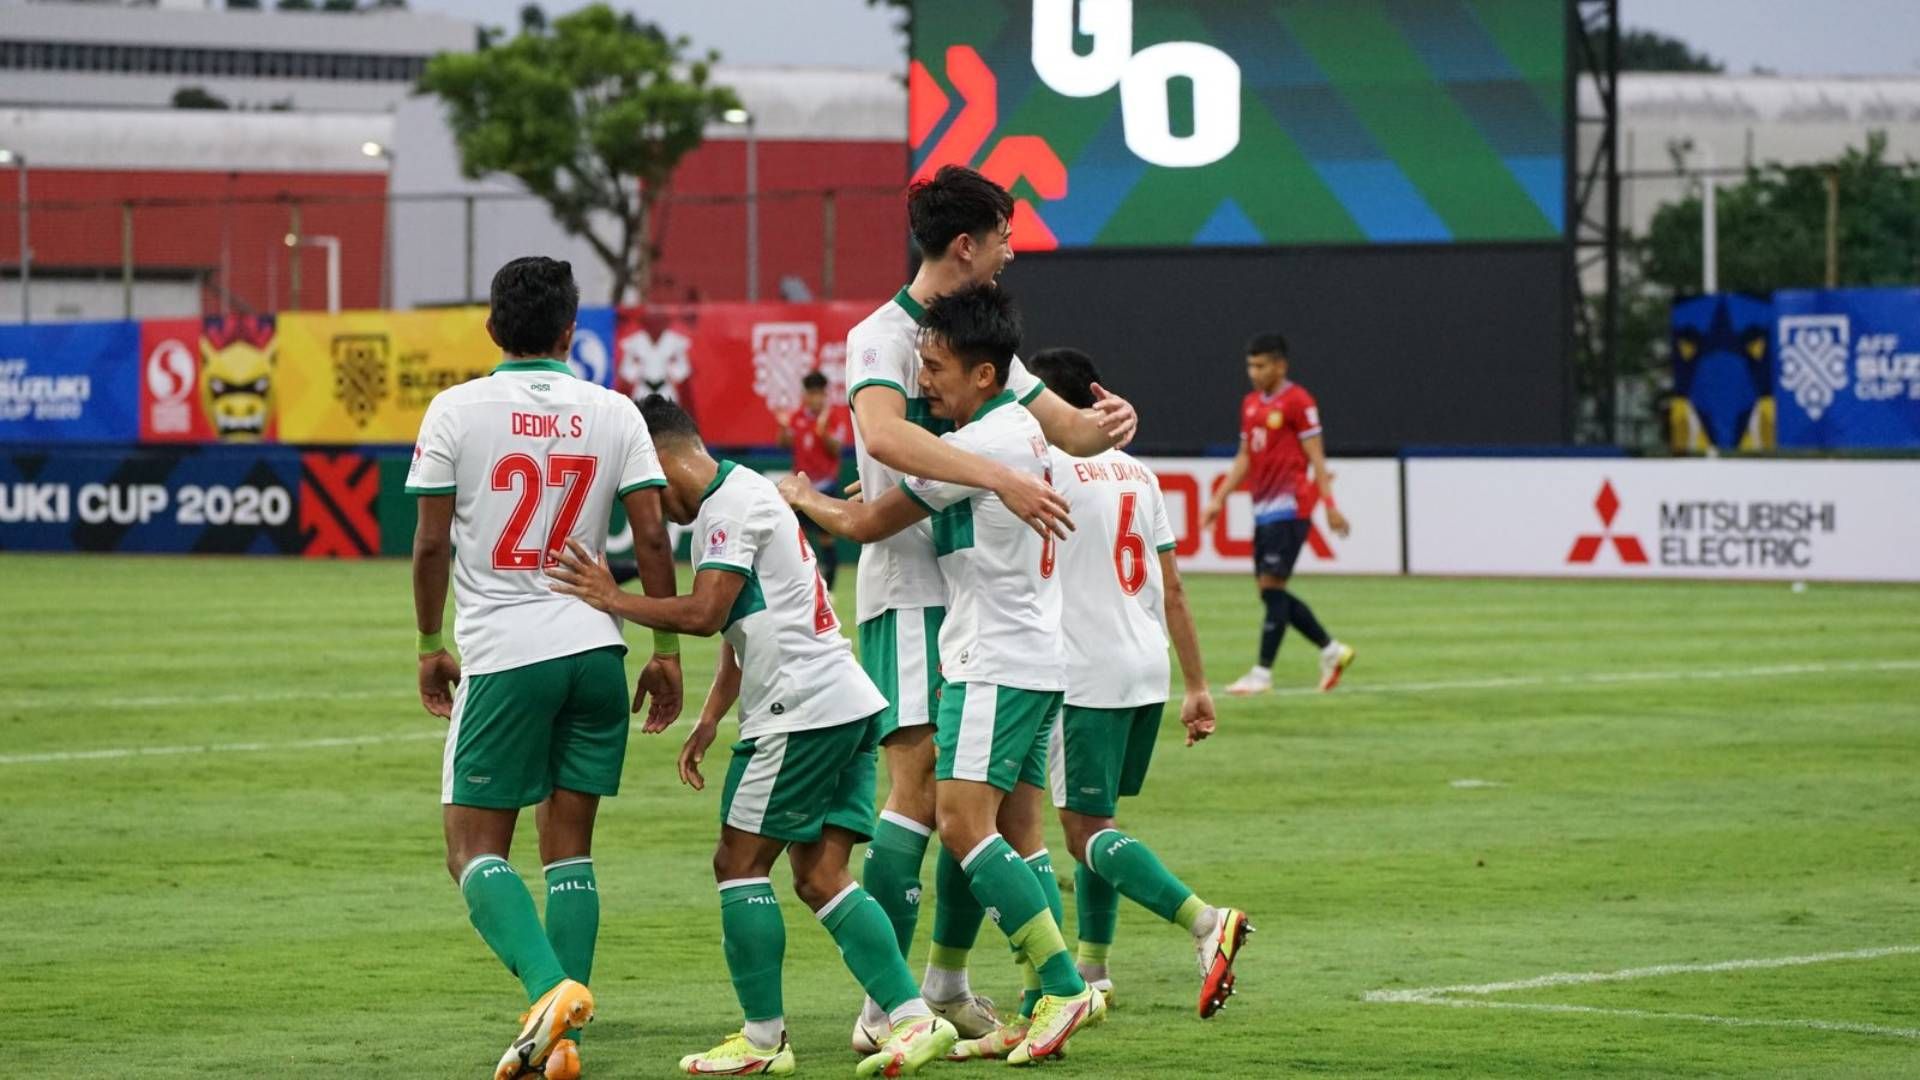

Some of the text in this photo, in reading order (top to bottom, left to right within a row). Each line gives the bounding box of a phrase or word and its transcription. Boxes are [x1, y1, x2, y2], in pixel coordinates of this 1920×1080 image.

[1074, 463, 1109, 482] EVAN
[77, 484, 169, 524] CUP
[175, 485, 292, 526] 2020
[491, 453, 597, 570] 27
[1659, 501, 1836, 532] MITSUBISHI
[1113, 492, 1148, 597] 6
[1659, 536, 1811, 568] ELECTRIC
